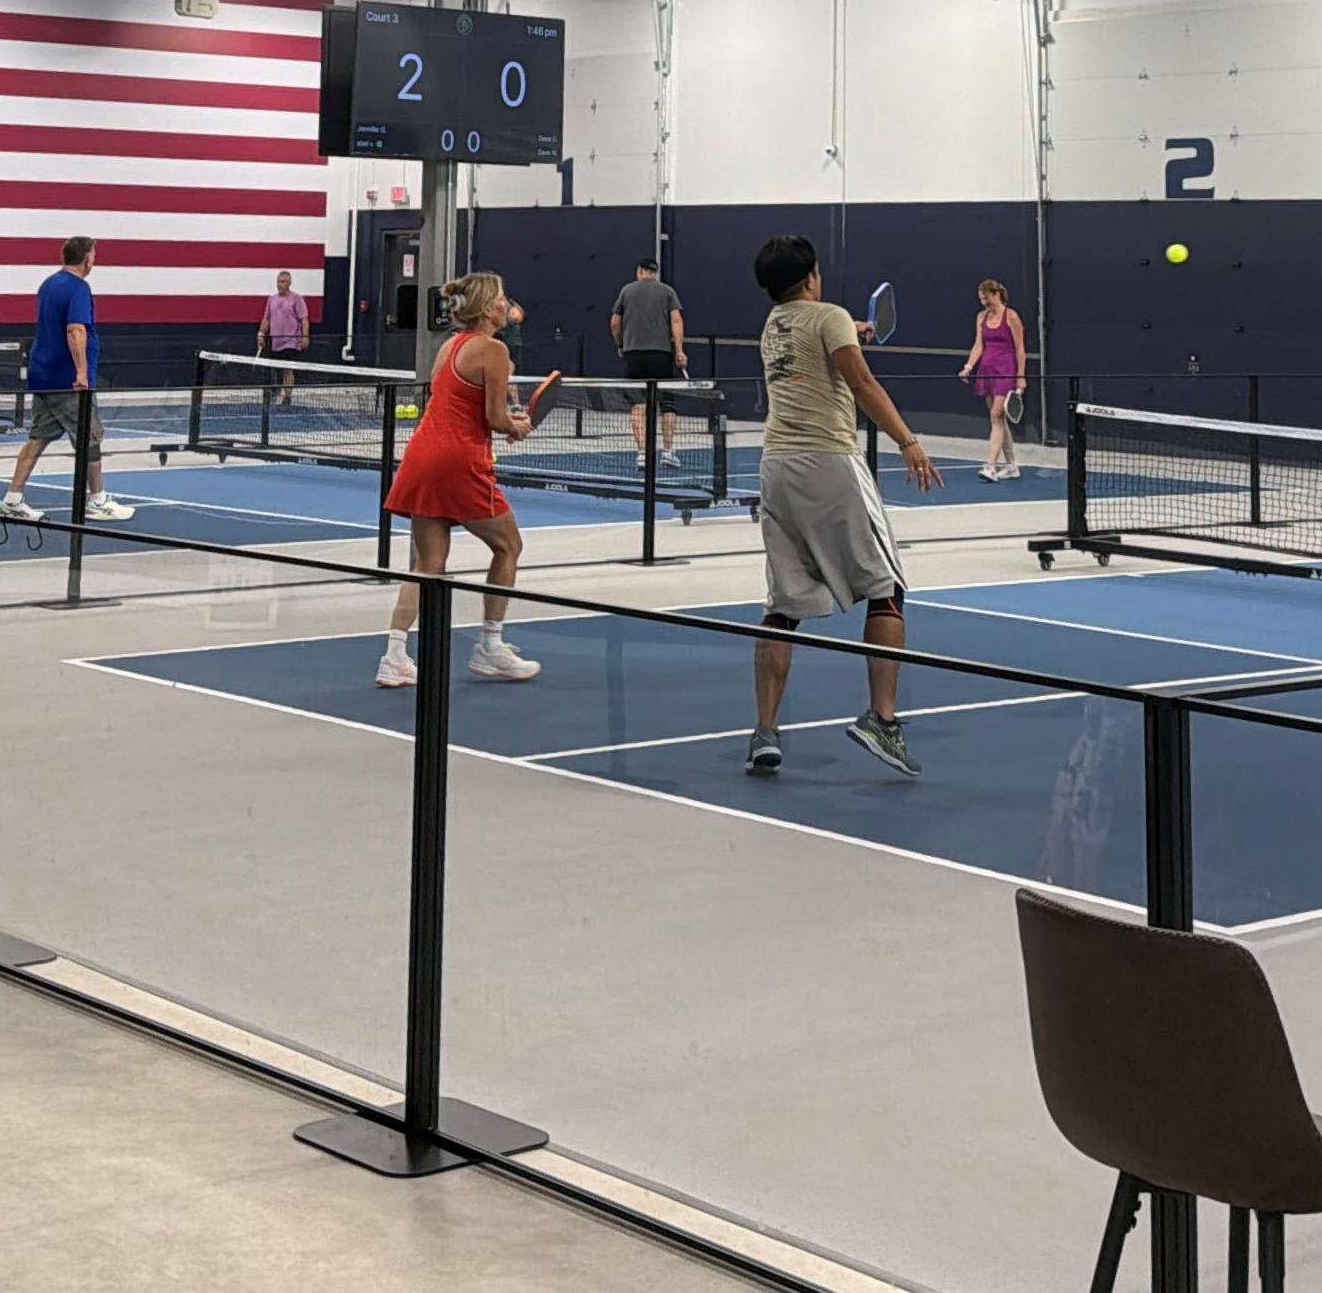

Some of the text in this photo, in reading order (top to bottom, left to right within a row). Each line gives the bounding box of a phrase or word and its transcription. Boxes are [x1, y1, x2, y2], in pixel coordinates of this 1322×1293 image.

[365, 10, 399, 24] Court 3
[544, 28, 557, 38] pm
[397, 52, 423, 101] 2
[500, 61, 526, 108] 0
[441, 129, 481, 153] 0 0
[1165, 137, 1215, 199] 2
